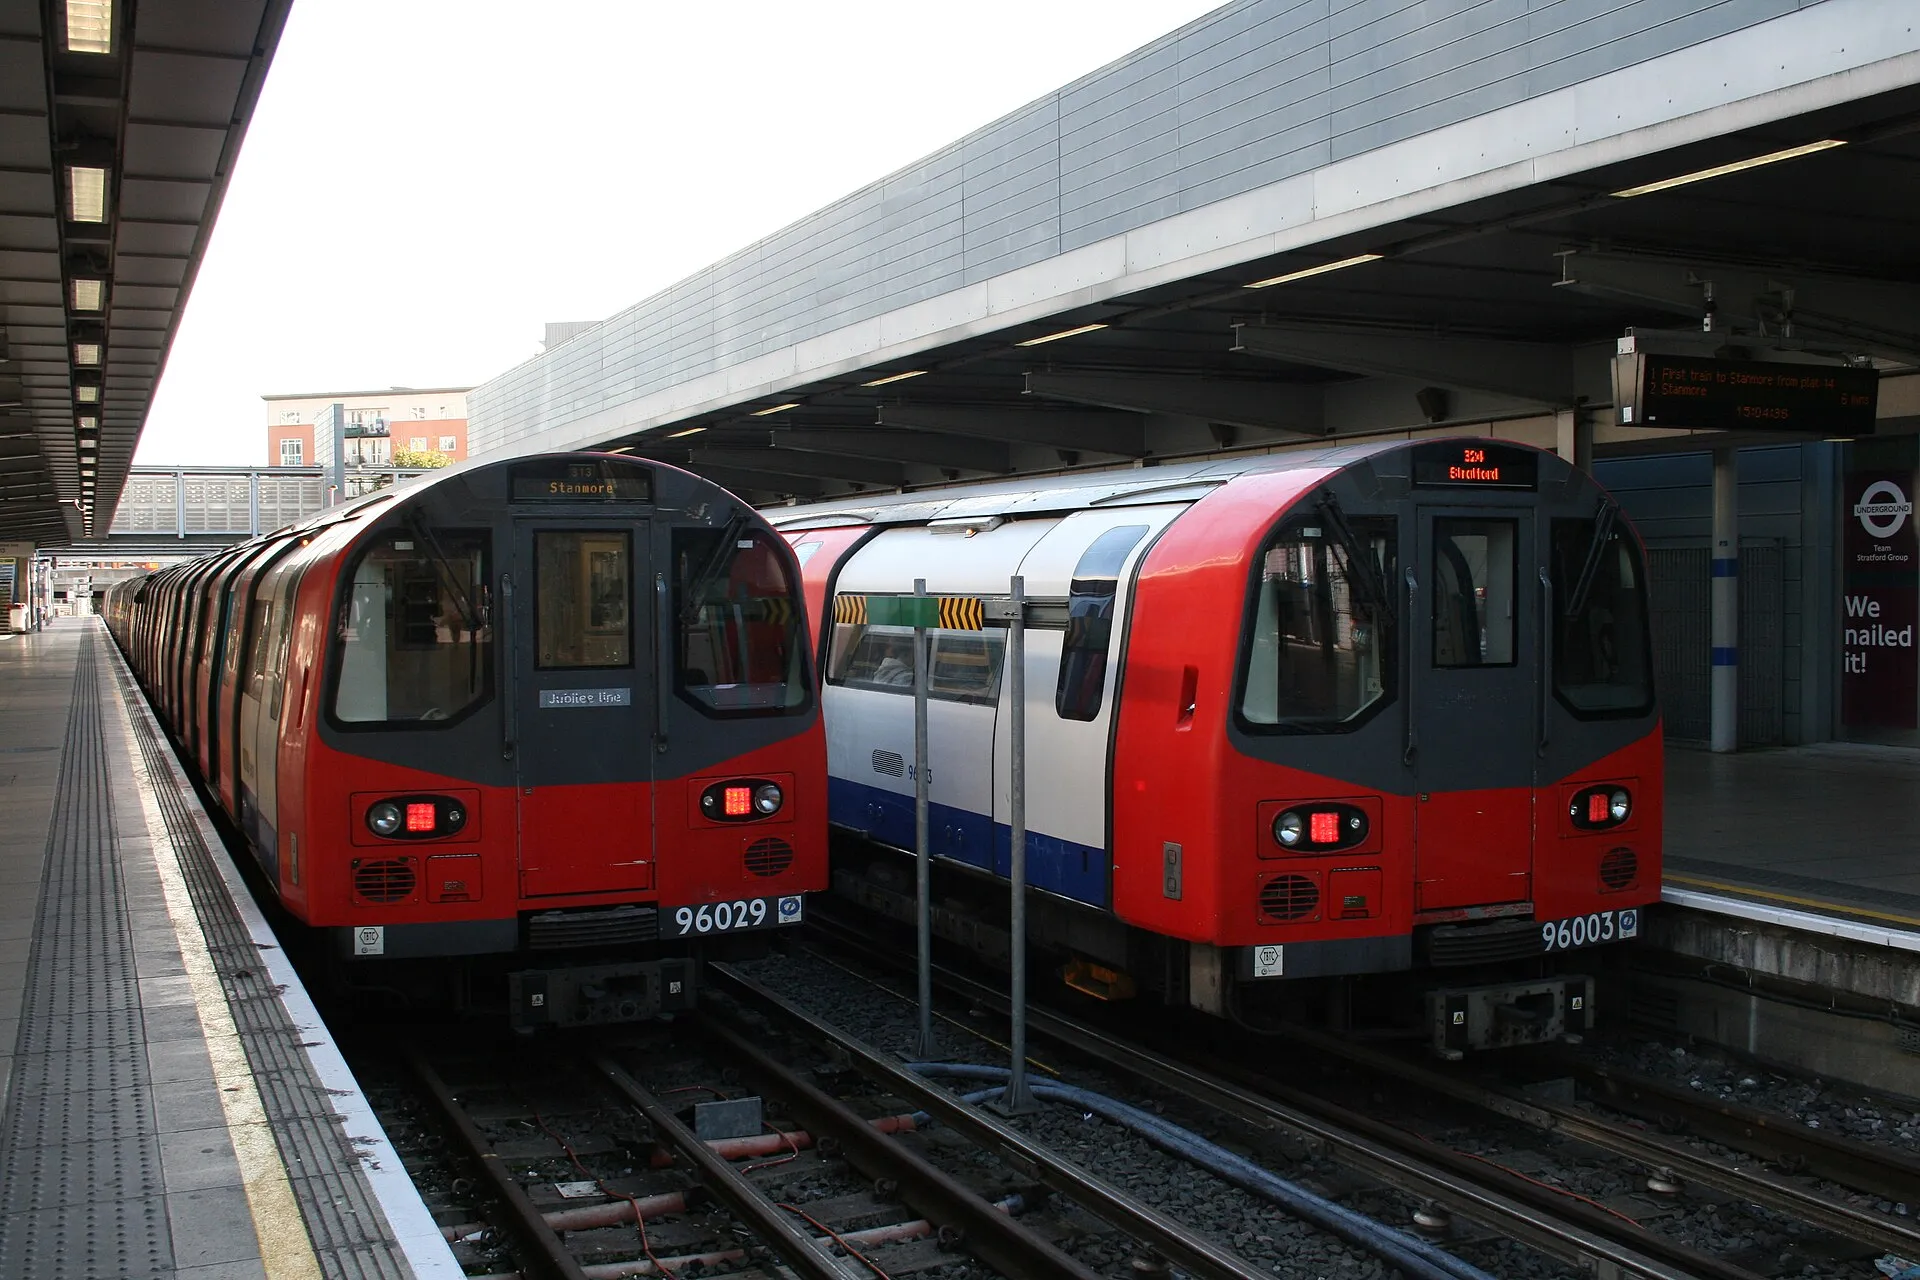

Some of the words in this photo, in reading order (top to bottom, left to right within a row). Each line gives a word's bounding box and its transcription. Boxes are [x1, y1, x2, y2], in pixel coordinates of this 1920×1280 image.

[1651, 368, 1656, 379] 1
[1661, 368, 1686, 380] First
[1690, 369, 1712, 381] train
[1716, 370, 1727, 383] to
[1730, 372, 1773, 385] Stanmore
[1777, 374, 1798, 387] from
[1649, 382, 1656, 395] 2
[1661, 382, 1707, 397] Stanmore
[550, 482, 614, 494] Stanmore
[1856, 505, 1910, 514] UNDERGROUND
[1873, 544, 1892, 552] Team
[1856, 553, 1886, 562] Stratford
[1887, 553, 1909, 562] Group
[1845, 595, 1880, 618] We
[1845, 624, 1912, 647] nailed
[1845, 652, 1866, 674] it!
[549, 692, 594, 704] Jubilee
[598, 691, 621, 703] line
[675, 898, 767, 935] 96029
[1542, 911, 1614, 952] 96003
